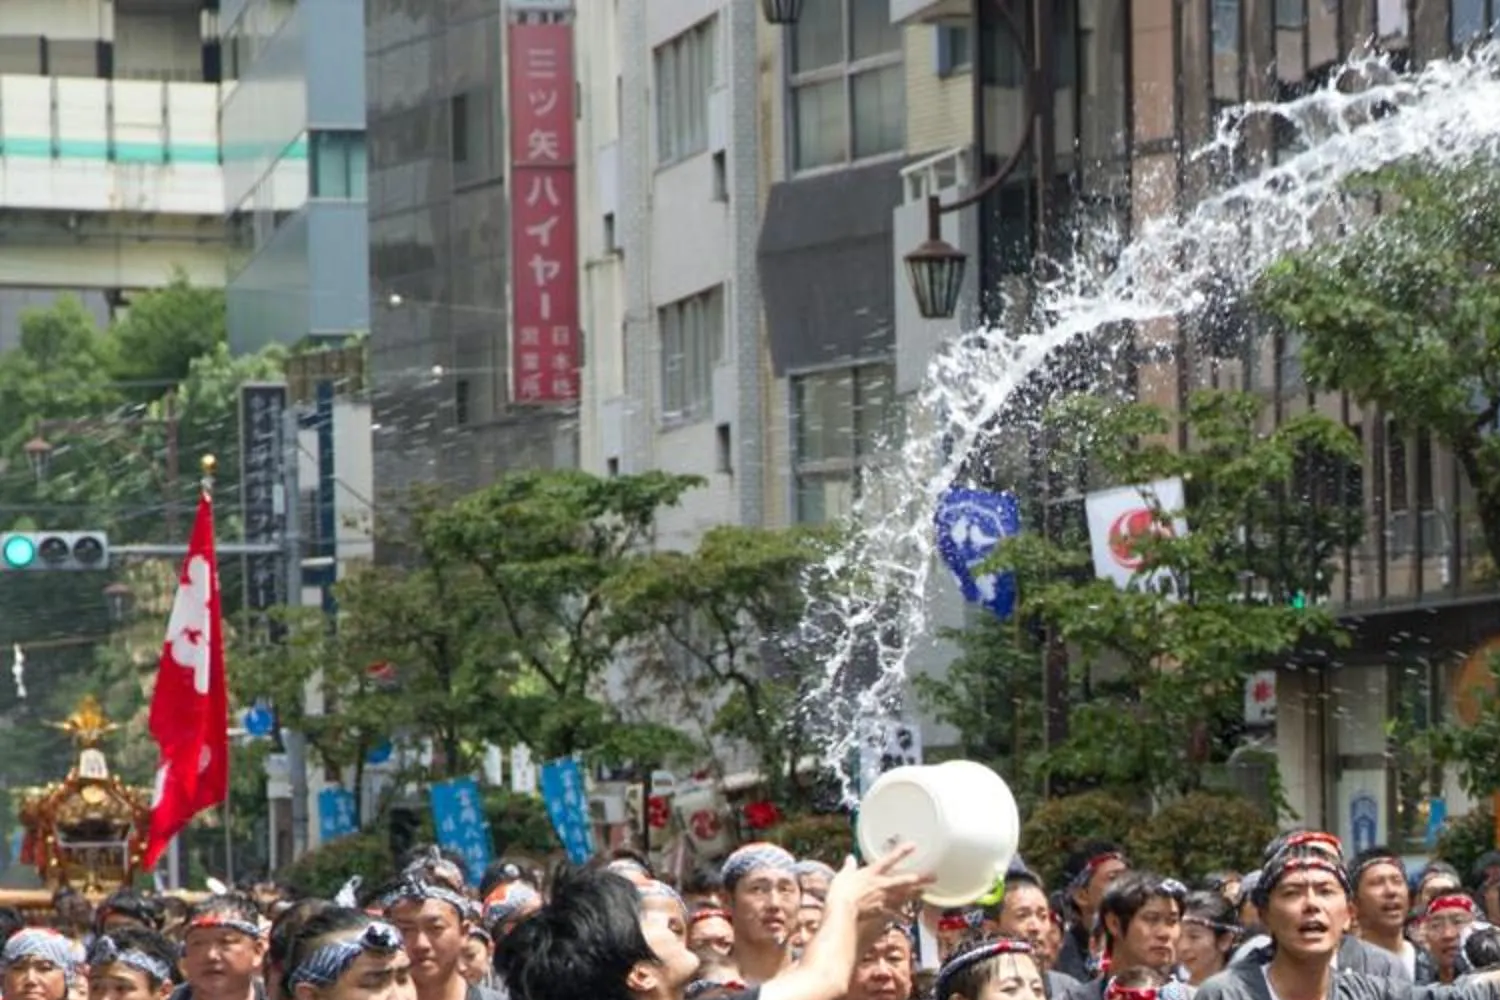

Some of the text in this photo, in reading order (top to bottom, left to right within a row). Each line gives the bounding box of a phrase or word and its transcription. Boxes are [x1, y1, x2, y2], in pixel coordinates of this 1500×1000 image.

[525, 48, 561, 321] 三ツ矢ハイヤー
